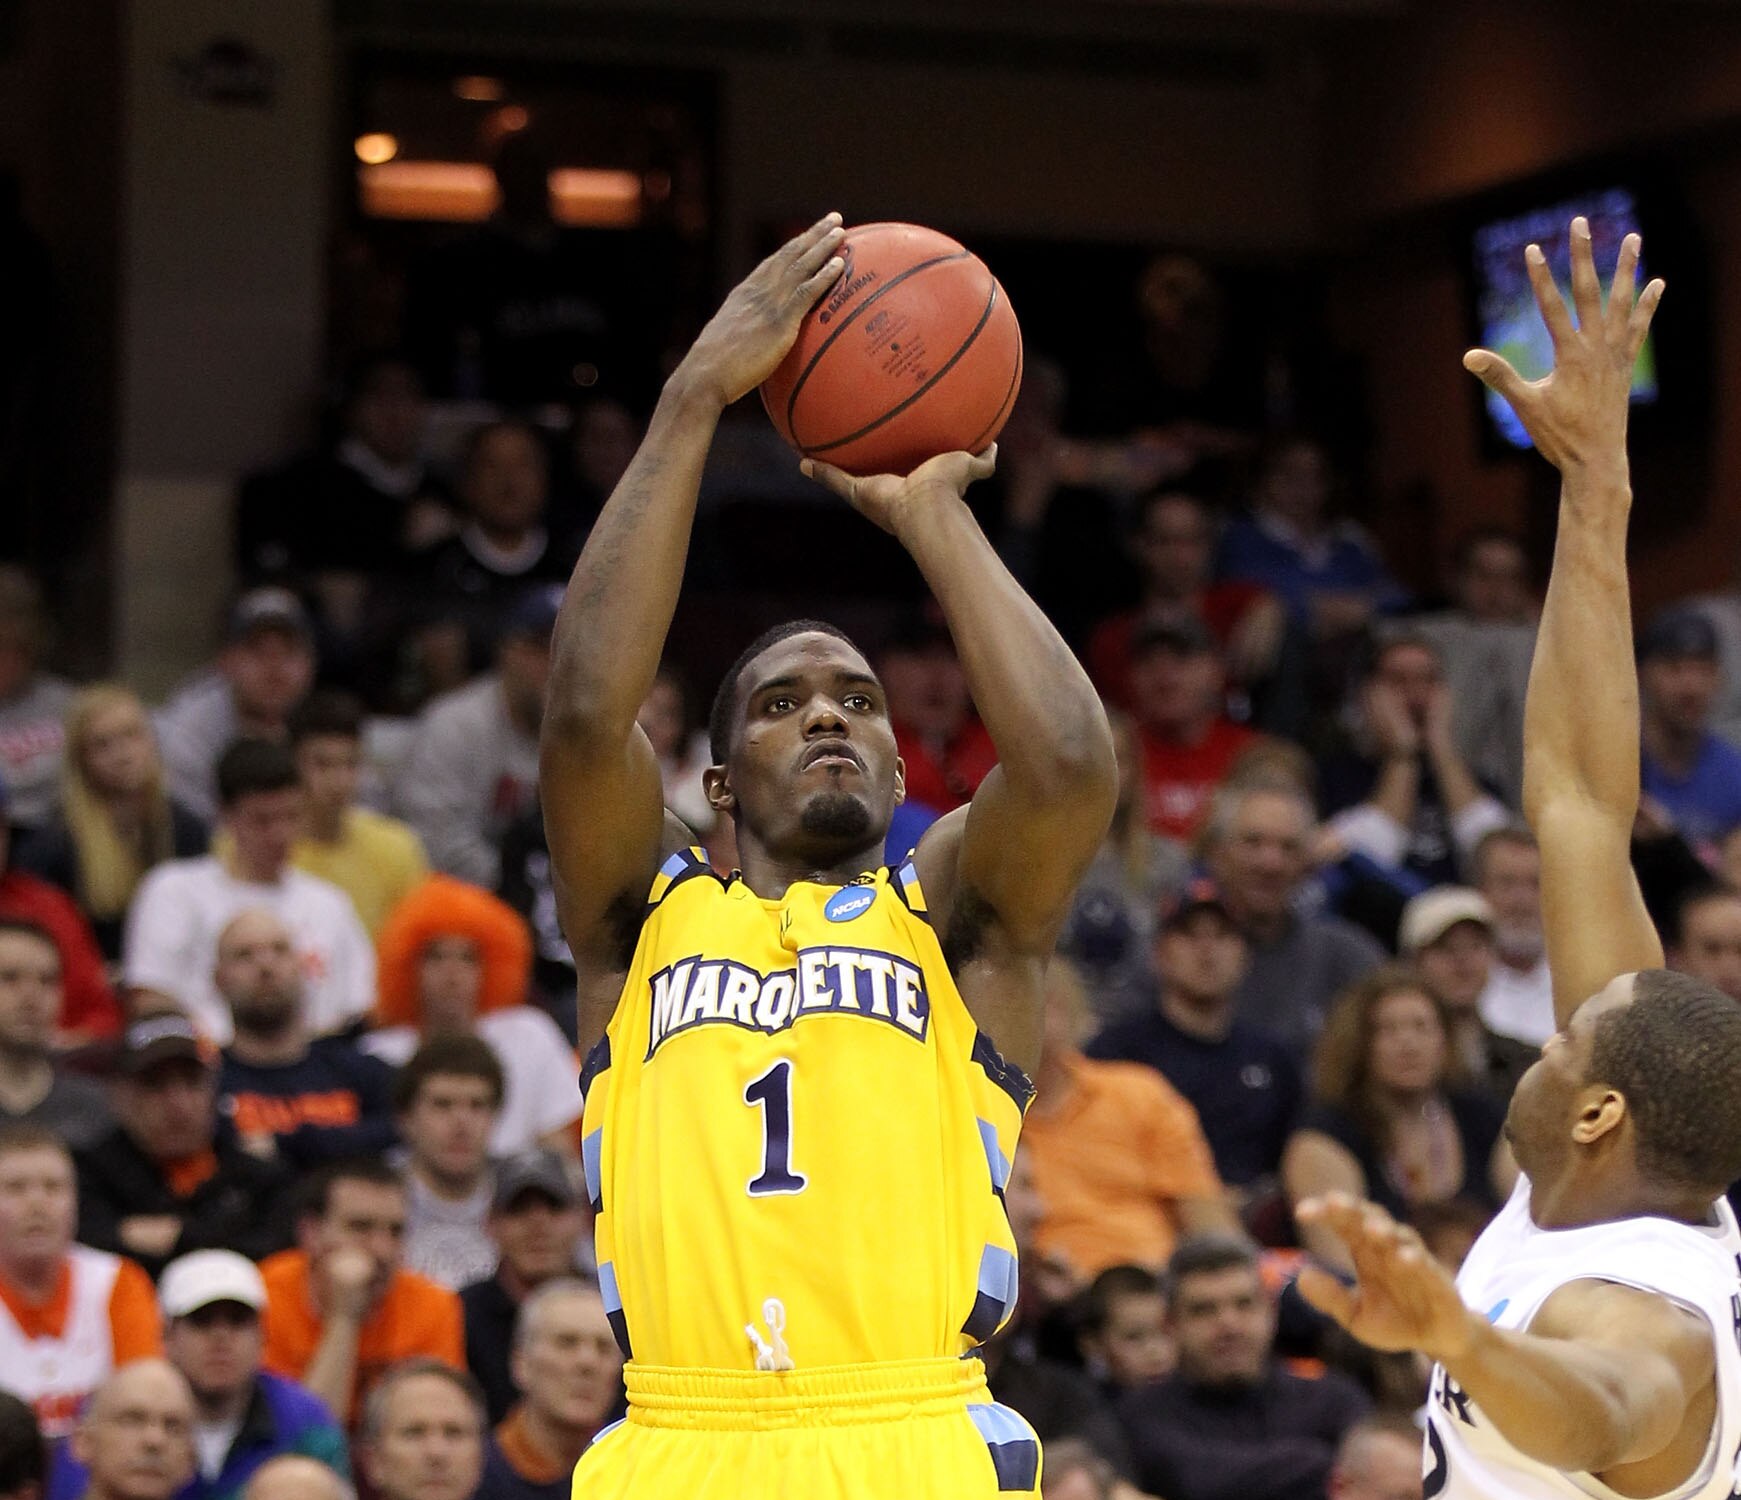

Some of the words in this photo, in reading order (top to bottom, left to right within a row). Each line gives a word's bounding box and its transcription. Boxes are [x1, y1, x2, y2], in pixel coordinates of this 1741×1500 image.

[831, 896, 871, 918] NCAA
[646, 949, 929, 1056] MARQETTE
[745, 1060, 805, 1196] 1
